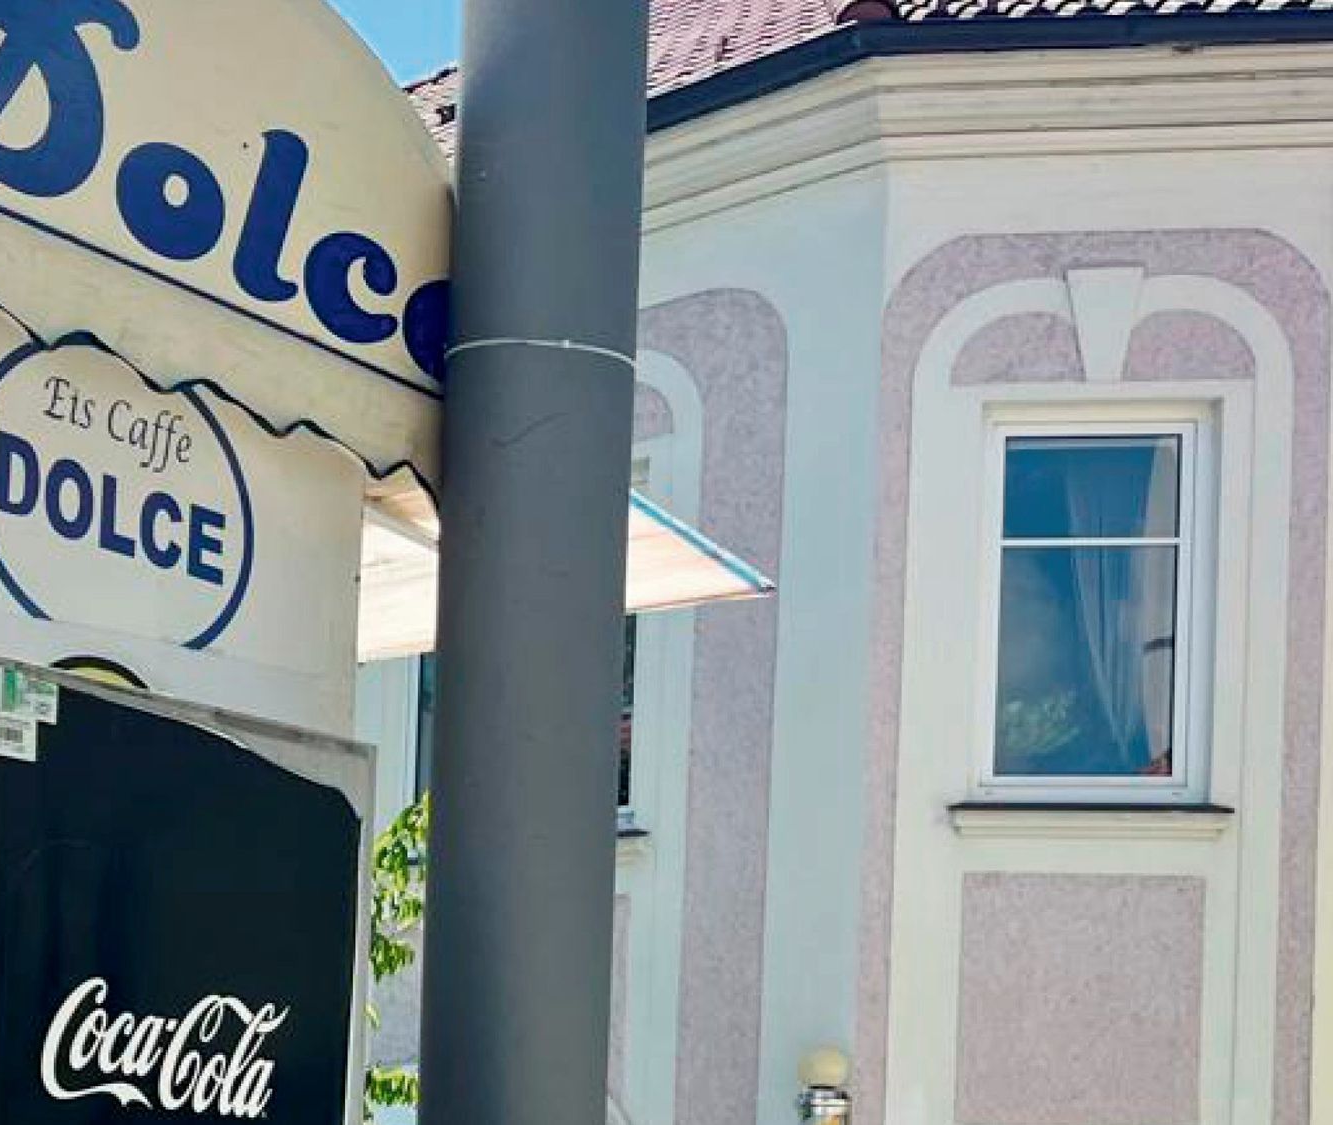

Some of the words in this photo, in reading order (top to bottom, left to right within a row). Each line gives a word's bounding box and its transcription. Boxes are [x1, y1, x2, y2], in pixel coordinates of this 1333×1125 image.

[42, 375, 96, 430] Eis
[107, 398, 193, 474] Caffe
[40, 976, 291, 1119] Coca-Cola
